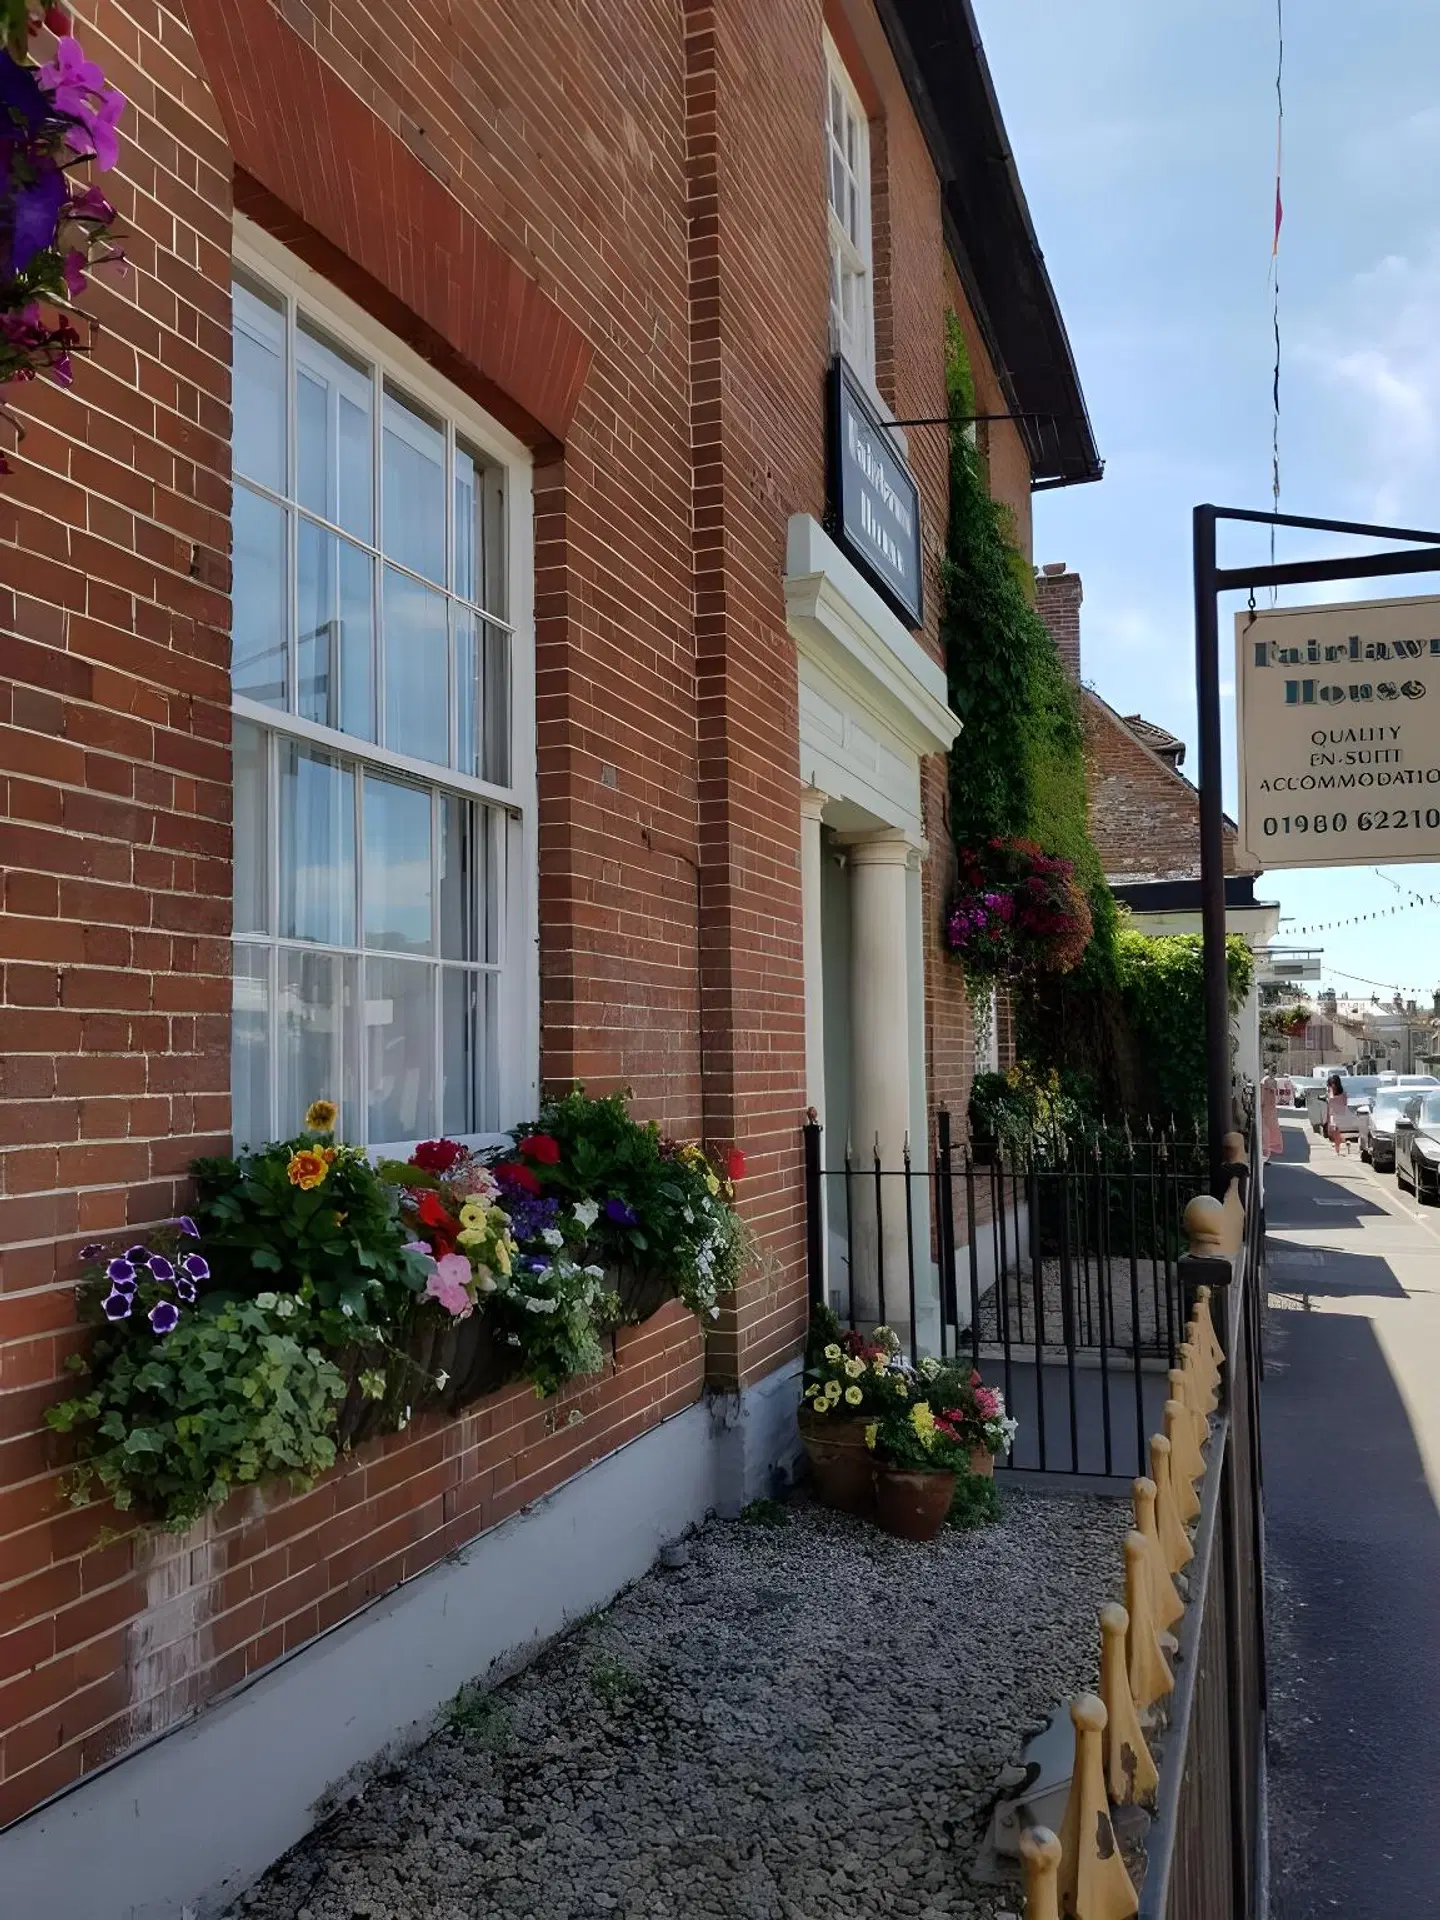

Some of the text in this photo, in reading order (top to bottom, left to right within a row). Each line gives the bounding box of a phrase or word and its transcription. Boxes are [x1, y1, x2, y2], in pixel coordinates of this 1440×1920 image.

[1284, 679, 1427, 706] House
[1311, 725, 1401, 748] QUALITY
[1263, 812, 1348, 836] 01980
